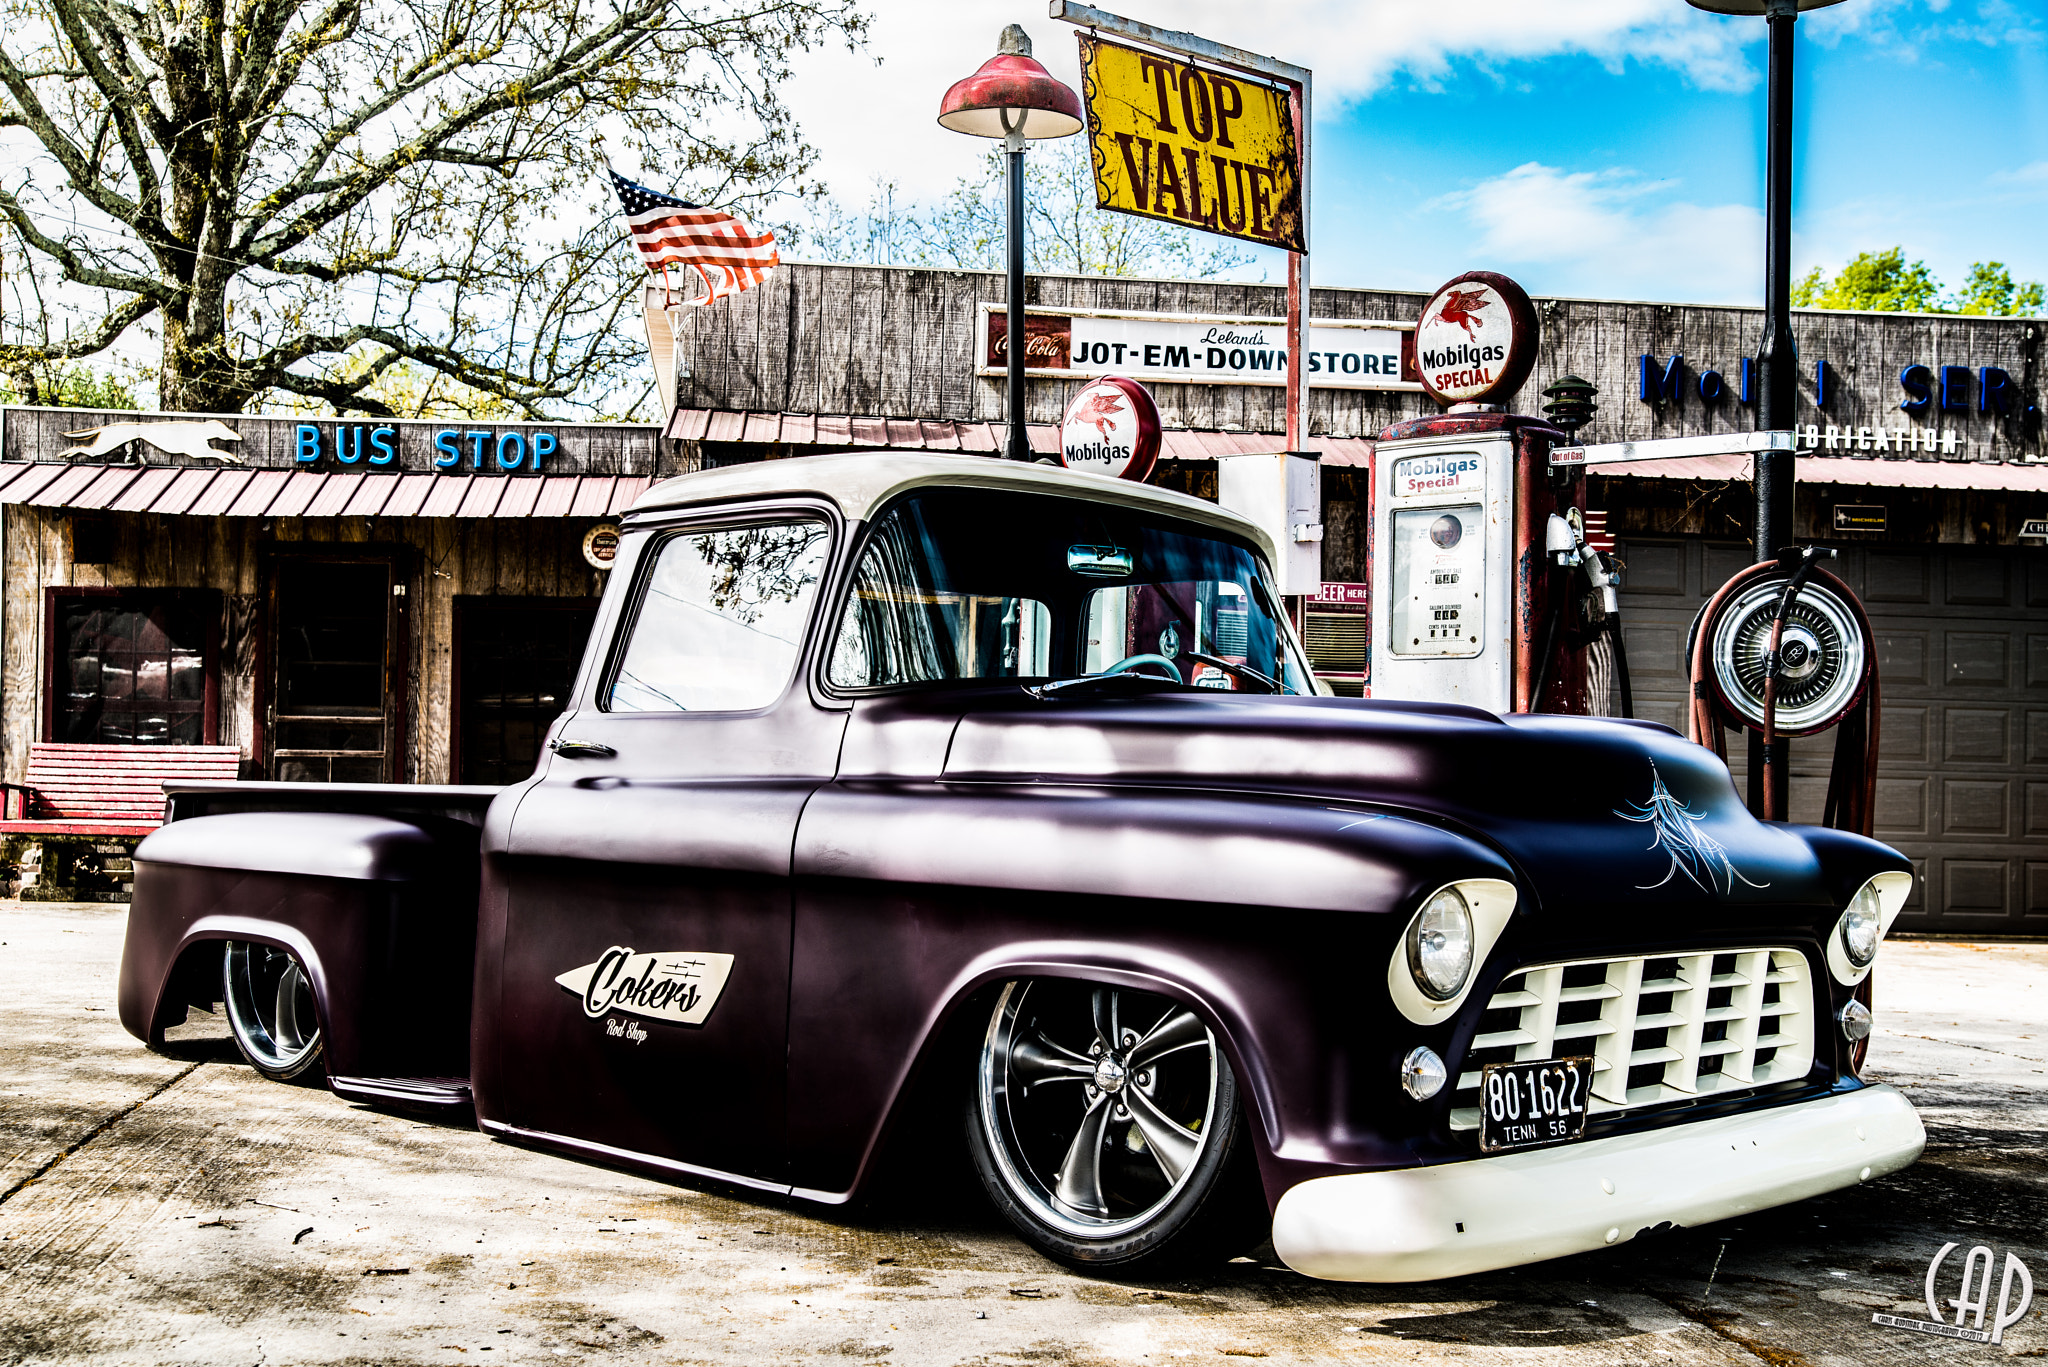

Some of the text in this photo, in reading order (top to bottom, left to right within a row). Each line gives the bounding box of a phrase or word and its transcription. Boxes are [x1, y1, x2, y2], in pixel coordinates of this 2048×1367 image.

[1140, 56, 1242, 149] TOP
[1115, 131, 1280, 240] VALUE
[1200, 328, 1269, 345] Leland's
[1309, 352, 1398, 375] STORE
[1423, 344, 1504, 370] Mobilgas
[1435, 368, 1493, 391] SPECIAL
[295, 424, 558, 470] BUS STOP
[1795, 424, 1958, 455] BRICATION
[1066, 442, 1130, 465] Mobilgas
[1551, 451, 1583, 461] Out of Gas
[1400, 457, 1478, 476] Mobilgas
[1407, 475, 1460, 491] Special
[586, 950, 702, 1013] Cokers
[606, 1018, 648, 1045] Rod Shop
[1503, 1120, 1567, 1142] TENN 56
